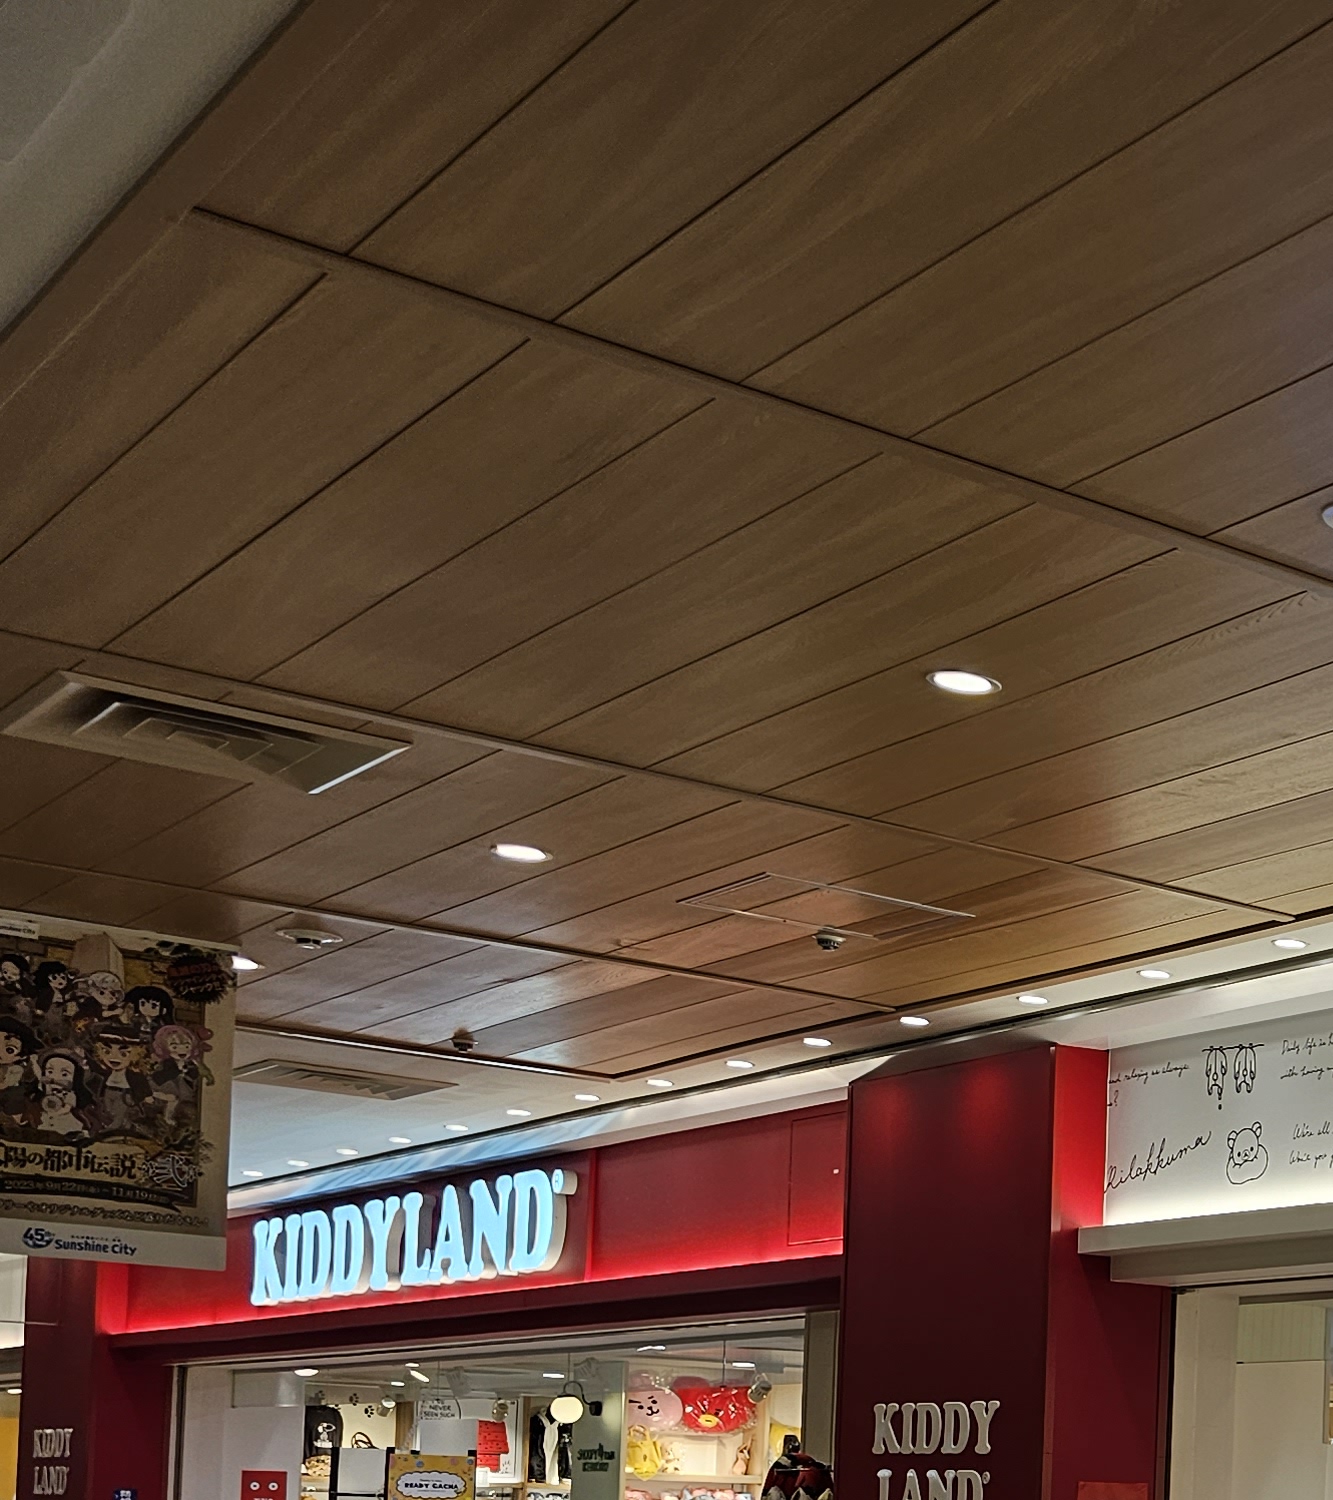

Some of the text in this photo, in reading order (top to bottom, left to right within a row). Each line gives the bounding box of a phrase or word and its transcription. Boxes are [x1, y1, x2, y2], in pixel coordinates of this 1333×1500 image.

[1103, 1130, 1212, 1193] Rilakkuma
[55, 1238, 109, 1254] Sunshine
[111, 1241, 138, 1257] City
[33, 1427, 75, 1459] KIDDY
[872, 1400, 1000, 1455] KIDDY
[33, 1465, 70, 1496] LAND
